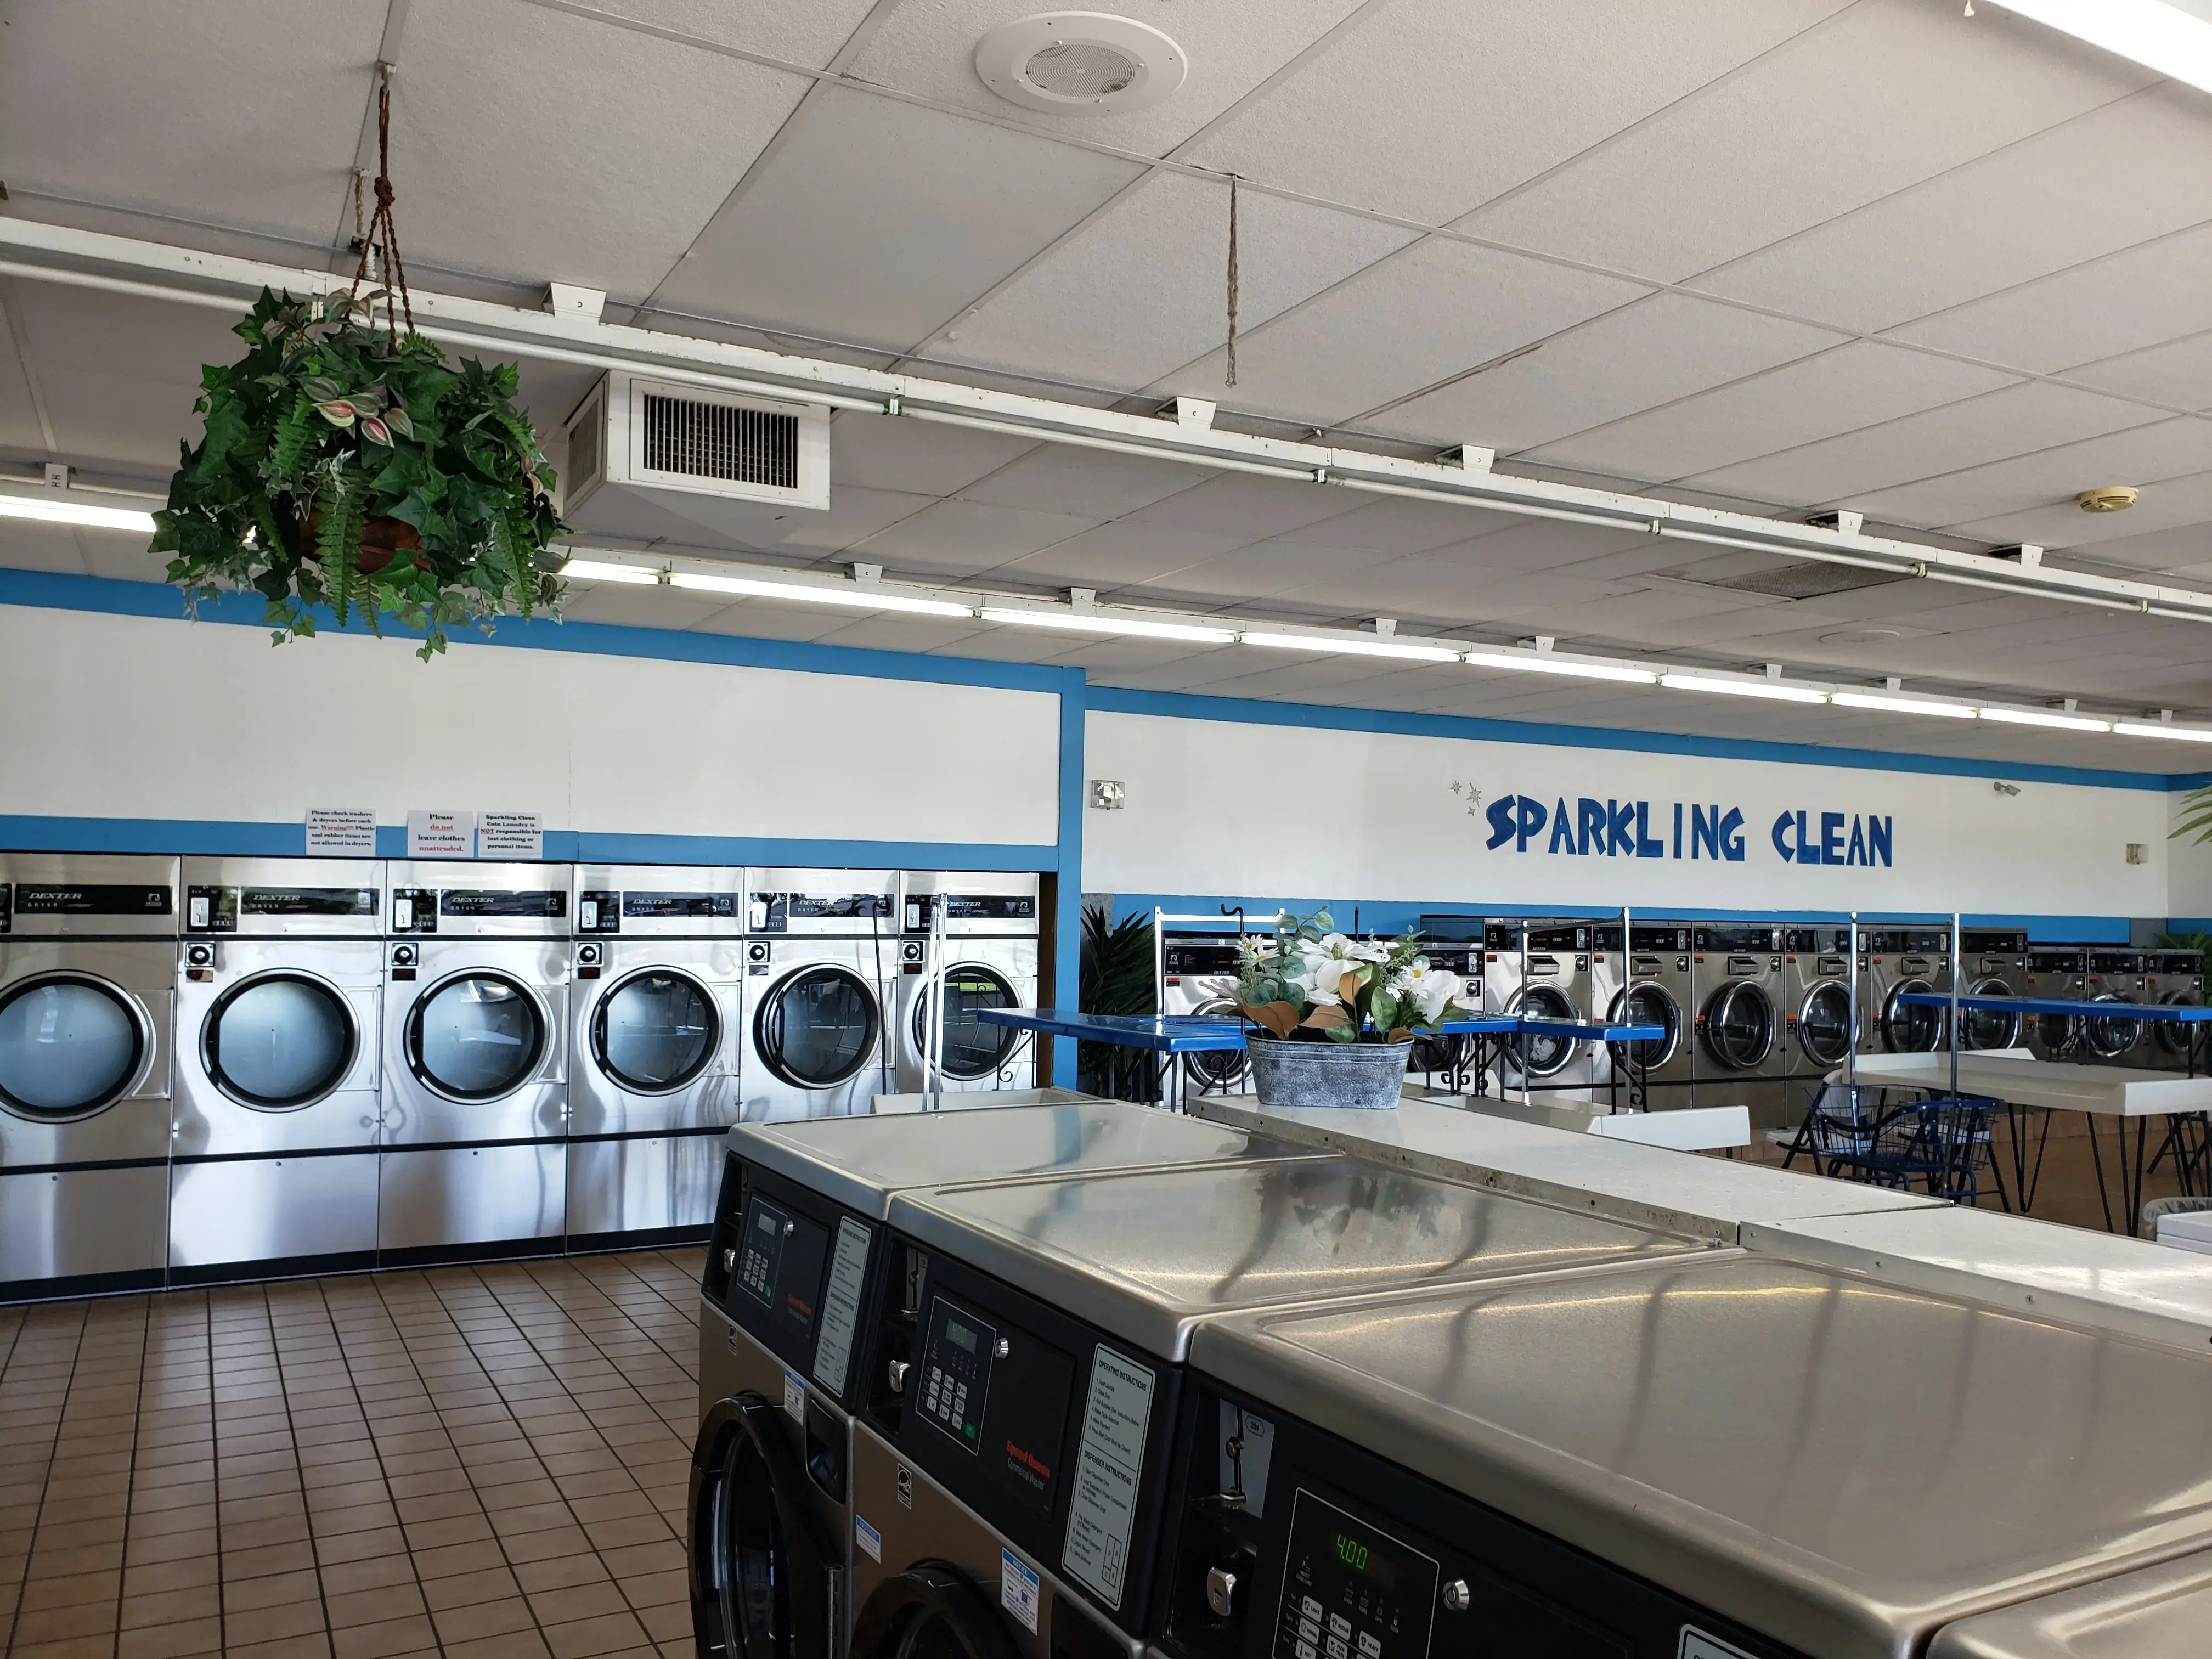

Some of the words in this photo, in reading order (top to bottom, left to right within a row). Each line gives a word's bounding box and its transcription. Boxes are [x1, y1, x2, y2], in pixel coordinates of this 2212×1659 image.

[1486, 794, 1745, 861] SPARKLING
[1771, 809, 1892, 867] CLEAN
[1098, 1360, 1119, 1376] OPERATING
[1119, 1371, 1147, 1391] INSTRUCTIONS
[1008, 1457, 1030, 1481] Commercial
[1030, 1472, 1045, 1491] Washer
[1084, 1450, 1104, 1468] DISPENSER
[1104, 1463, 1132, 1486] INSTRUCTIONS
[1012, 1559, 1028, 1575] NOTICE
[1337, 1534, 1368, 1570] 4.00
[1311, 1605, 1320, 1615] LIGHT
[1307, 1628, 1317, 1639] NORMAL
[1367, 1642, 1379, 1652] HEAVY
